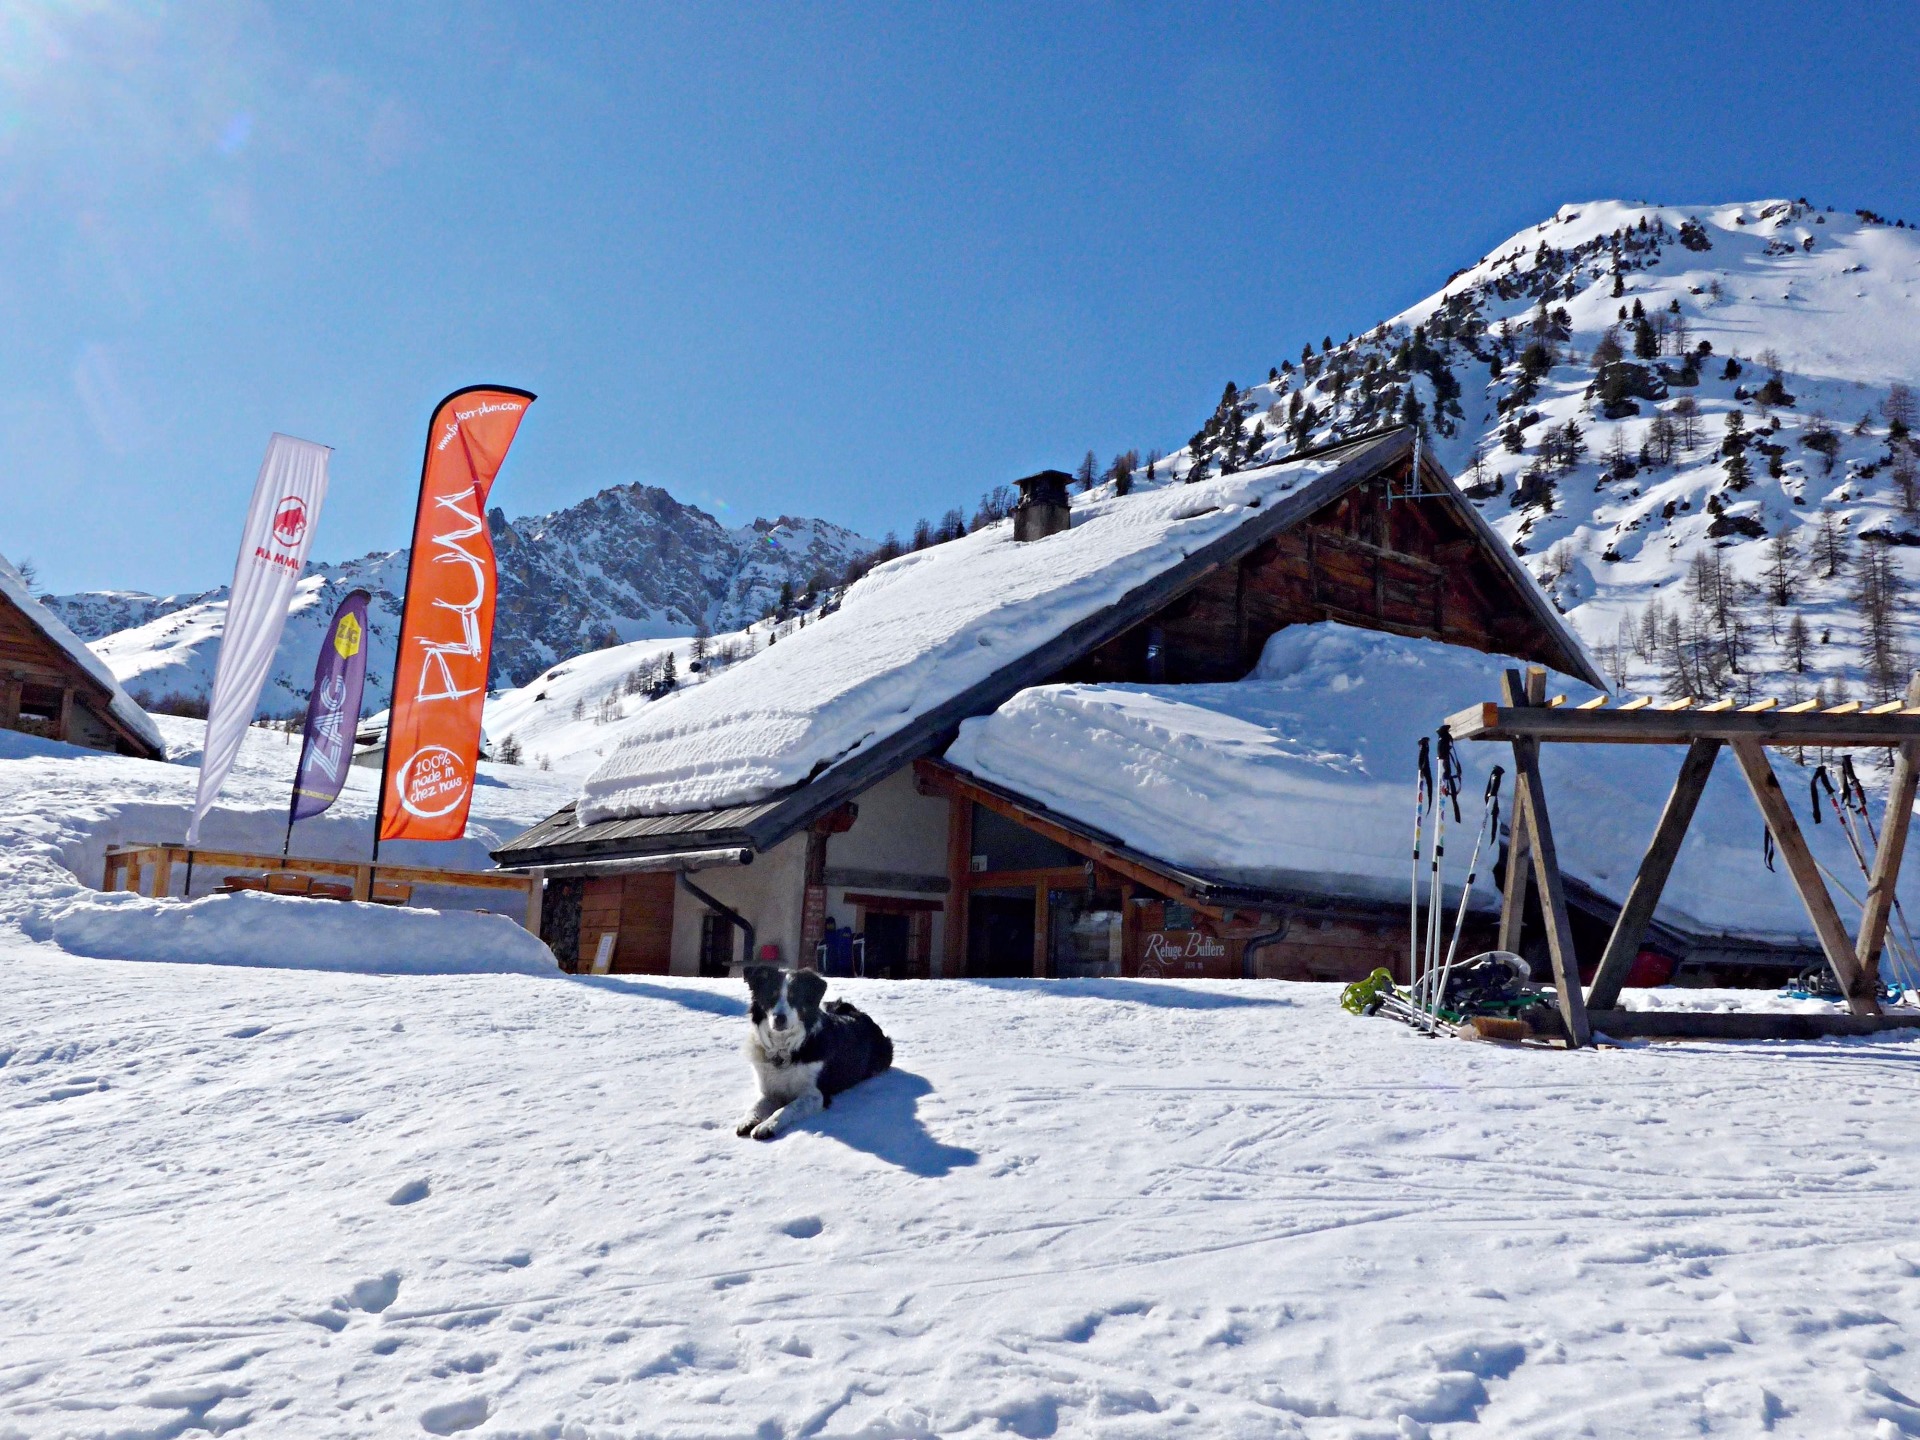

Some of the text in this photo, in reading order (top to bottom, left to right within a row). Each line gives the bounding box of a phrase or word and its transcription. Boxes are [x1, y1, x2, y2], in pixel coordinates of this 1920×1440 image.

[413, 486, 485, 702] PLUM
[302, 675, 346, 783] ZAG
[412, 765, 455, 790] made in
[414, 751, 452, 777] 100%
[410, 777, 462, 803] chez nous
[1144, 933, 1183, 965] Refuge
